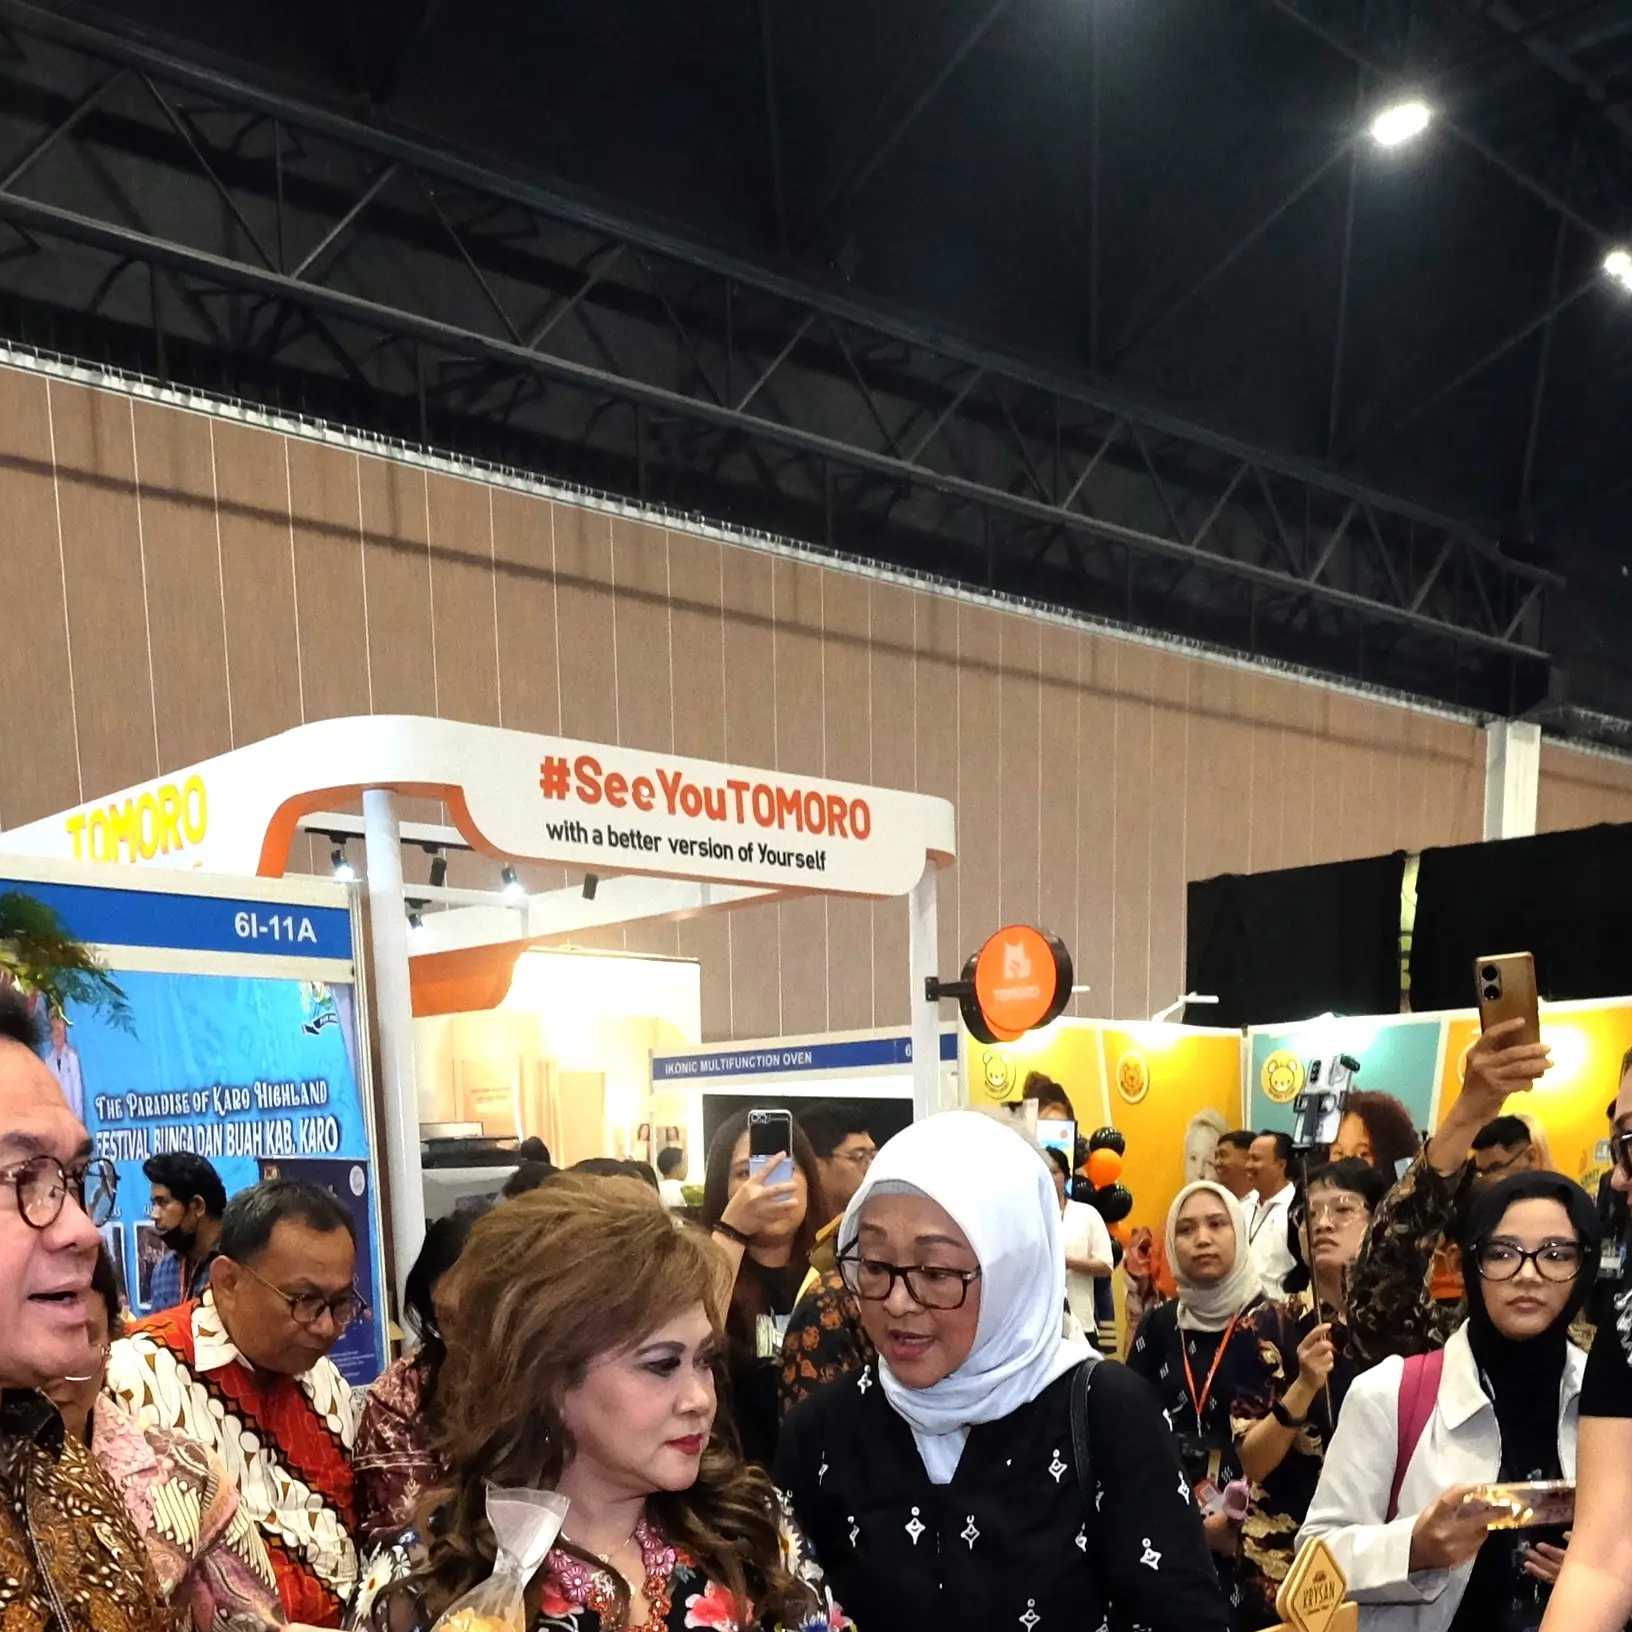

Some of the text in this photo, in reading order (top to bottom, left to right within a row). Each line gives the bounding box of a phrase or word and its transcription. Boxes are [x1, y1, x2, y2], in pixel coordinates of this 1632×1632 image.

[64, 774, 208, 863] TOMORO
[539, 755, 872, 841] #SeeYouTOMORO
[546, 820, 588, 845] with
[592, 828, 604, 846] a
[607, 825, 662, 853] better
[668, 837, 734, 862] version
[737, 842, 754, 864] of
[234, 911, 317, 943] 6I-11A
[664, 1051, 812, 1075] IKONIC MULTIFUNCTION OVEN
[95, 1116, 340, 1160] FESTIVAL BUNGA DAN BUAH KAB. KARO
[1302, 1580, 1335, 1609] KRYSAN
